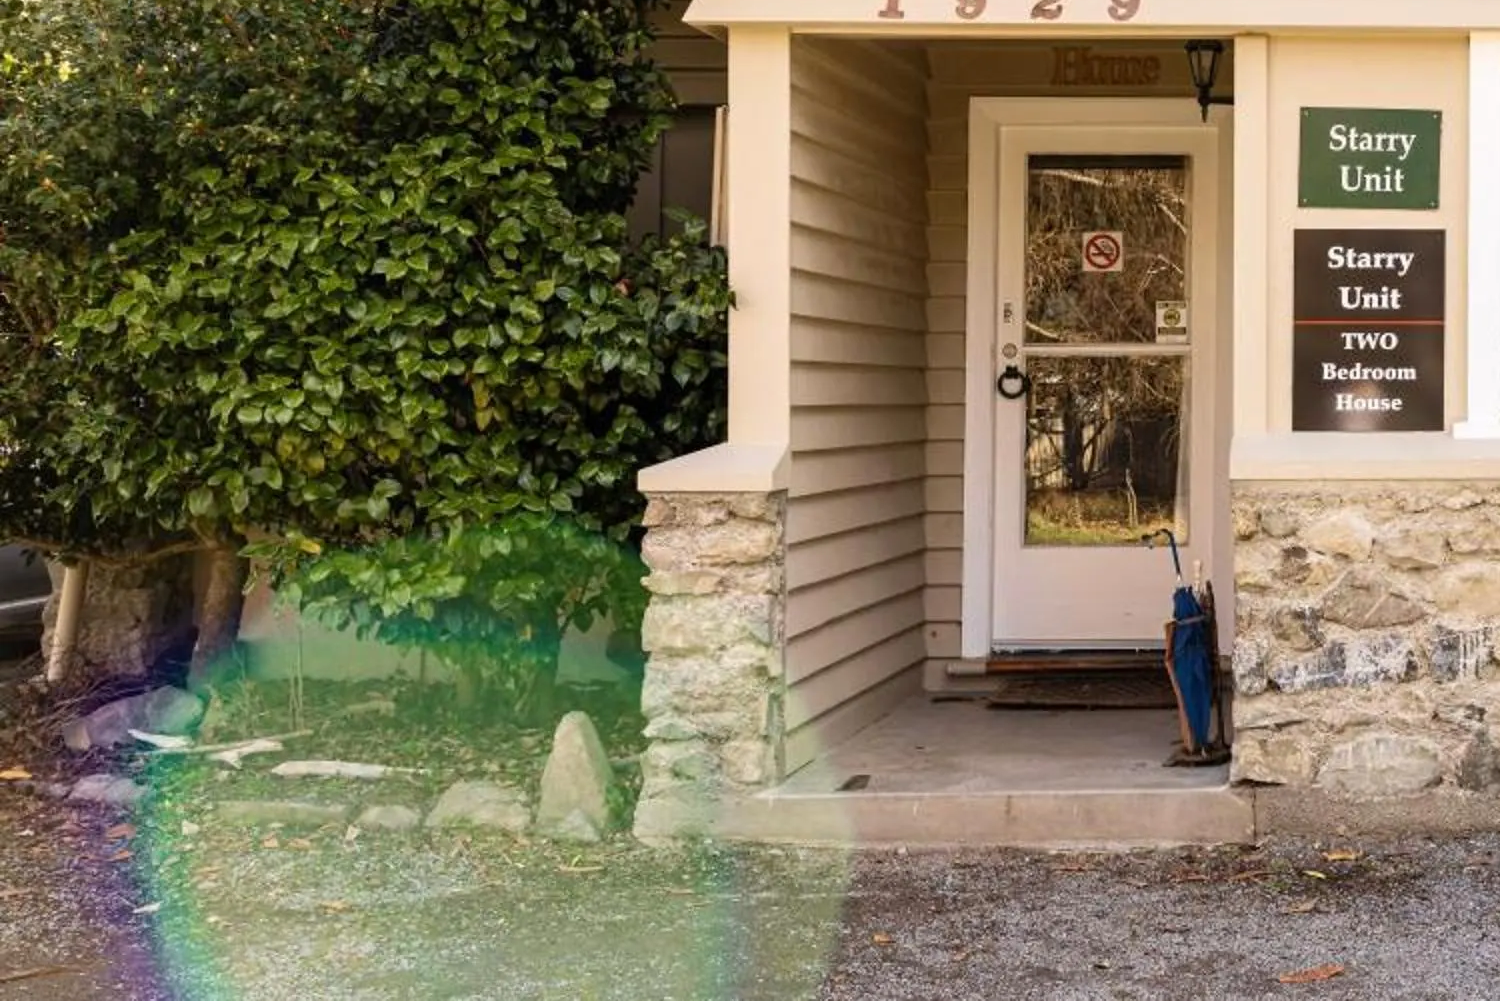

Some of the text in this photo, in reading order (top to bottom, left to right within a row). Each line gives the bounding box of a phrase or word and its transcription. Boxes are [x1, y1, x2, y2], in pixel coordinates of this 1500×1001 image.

[1329, 124, 1417, 160] Starry
[1340, 165, 1405, 192] Unit
[1327, 246, 1415, 276] Starry
[1338, 286, 1402, 309] Unit
[1341, 332, 1399, 350] TWO
[1322, 362, 1417, 381] Bedroom
[1335, 393, 1403, 411] House
